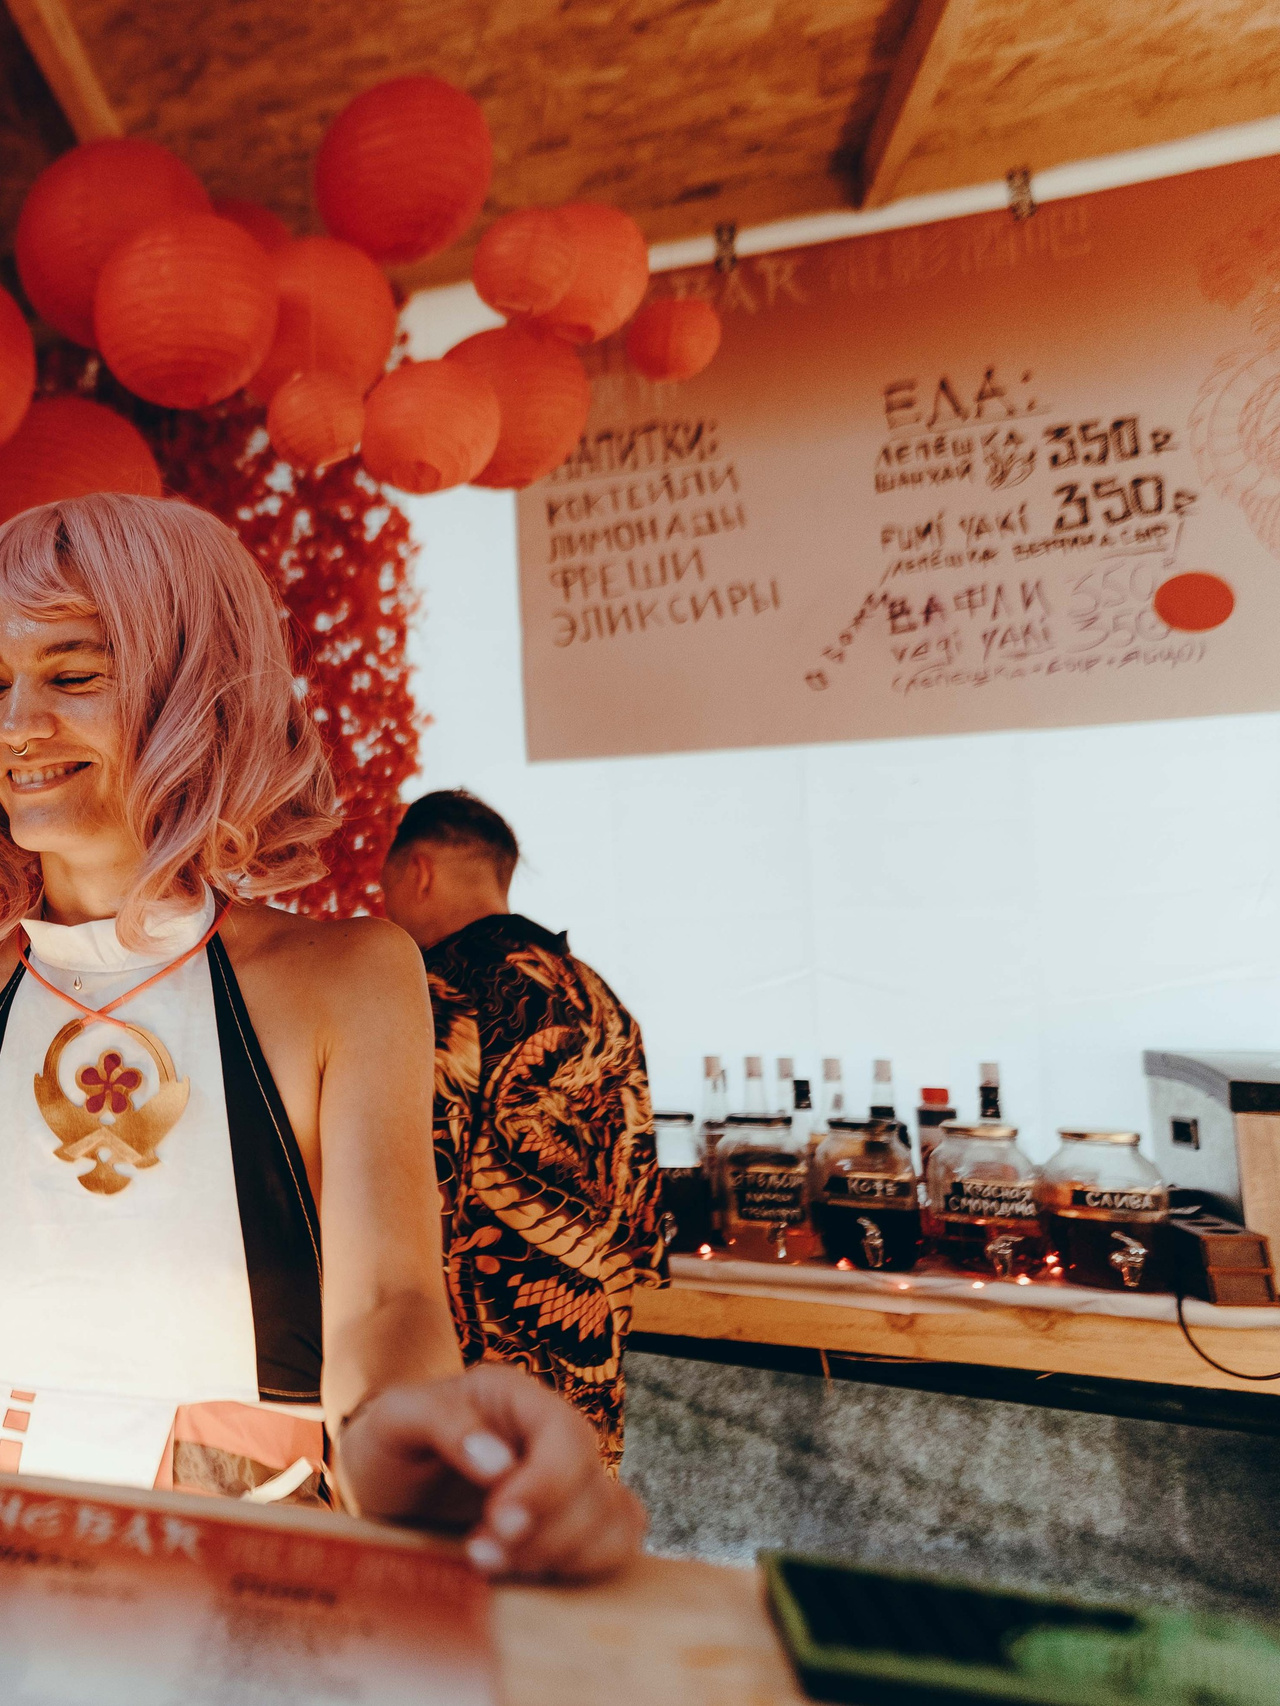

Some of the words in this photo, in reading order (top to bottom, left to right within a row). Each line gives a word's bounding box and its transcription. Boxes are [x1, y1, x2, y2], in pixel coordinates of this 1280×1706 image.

[1043, 414, 1140, 471] 350
[545, 461, 740, 529] КОКТЕЙЛИ
[1052, 473, 1165, 534] 350
[548, 502, 747, 563] ЛИМОНАДЫ
[550, 546, 705, 602] ФРЕШИ
[551, 578, 782, 648] ЭЛИКСИРЫ
[888, 578, 1053, 636] ВАФЛИ
[1064, 606, 1172, 654] 350
[847, 1179, 897, 1197] КОФЕ
[1085, 1192, 1155, 1210] СЛИВА
